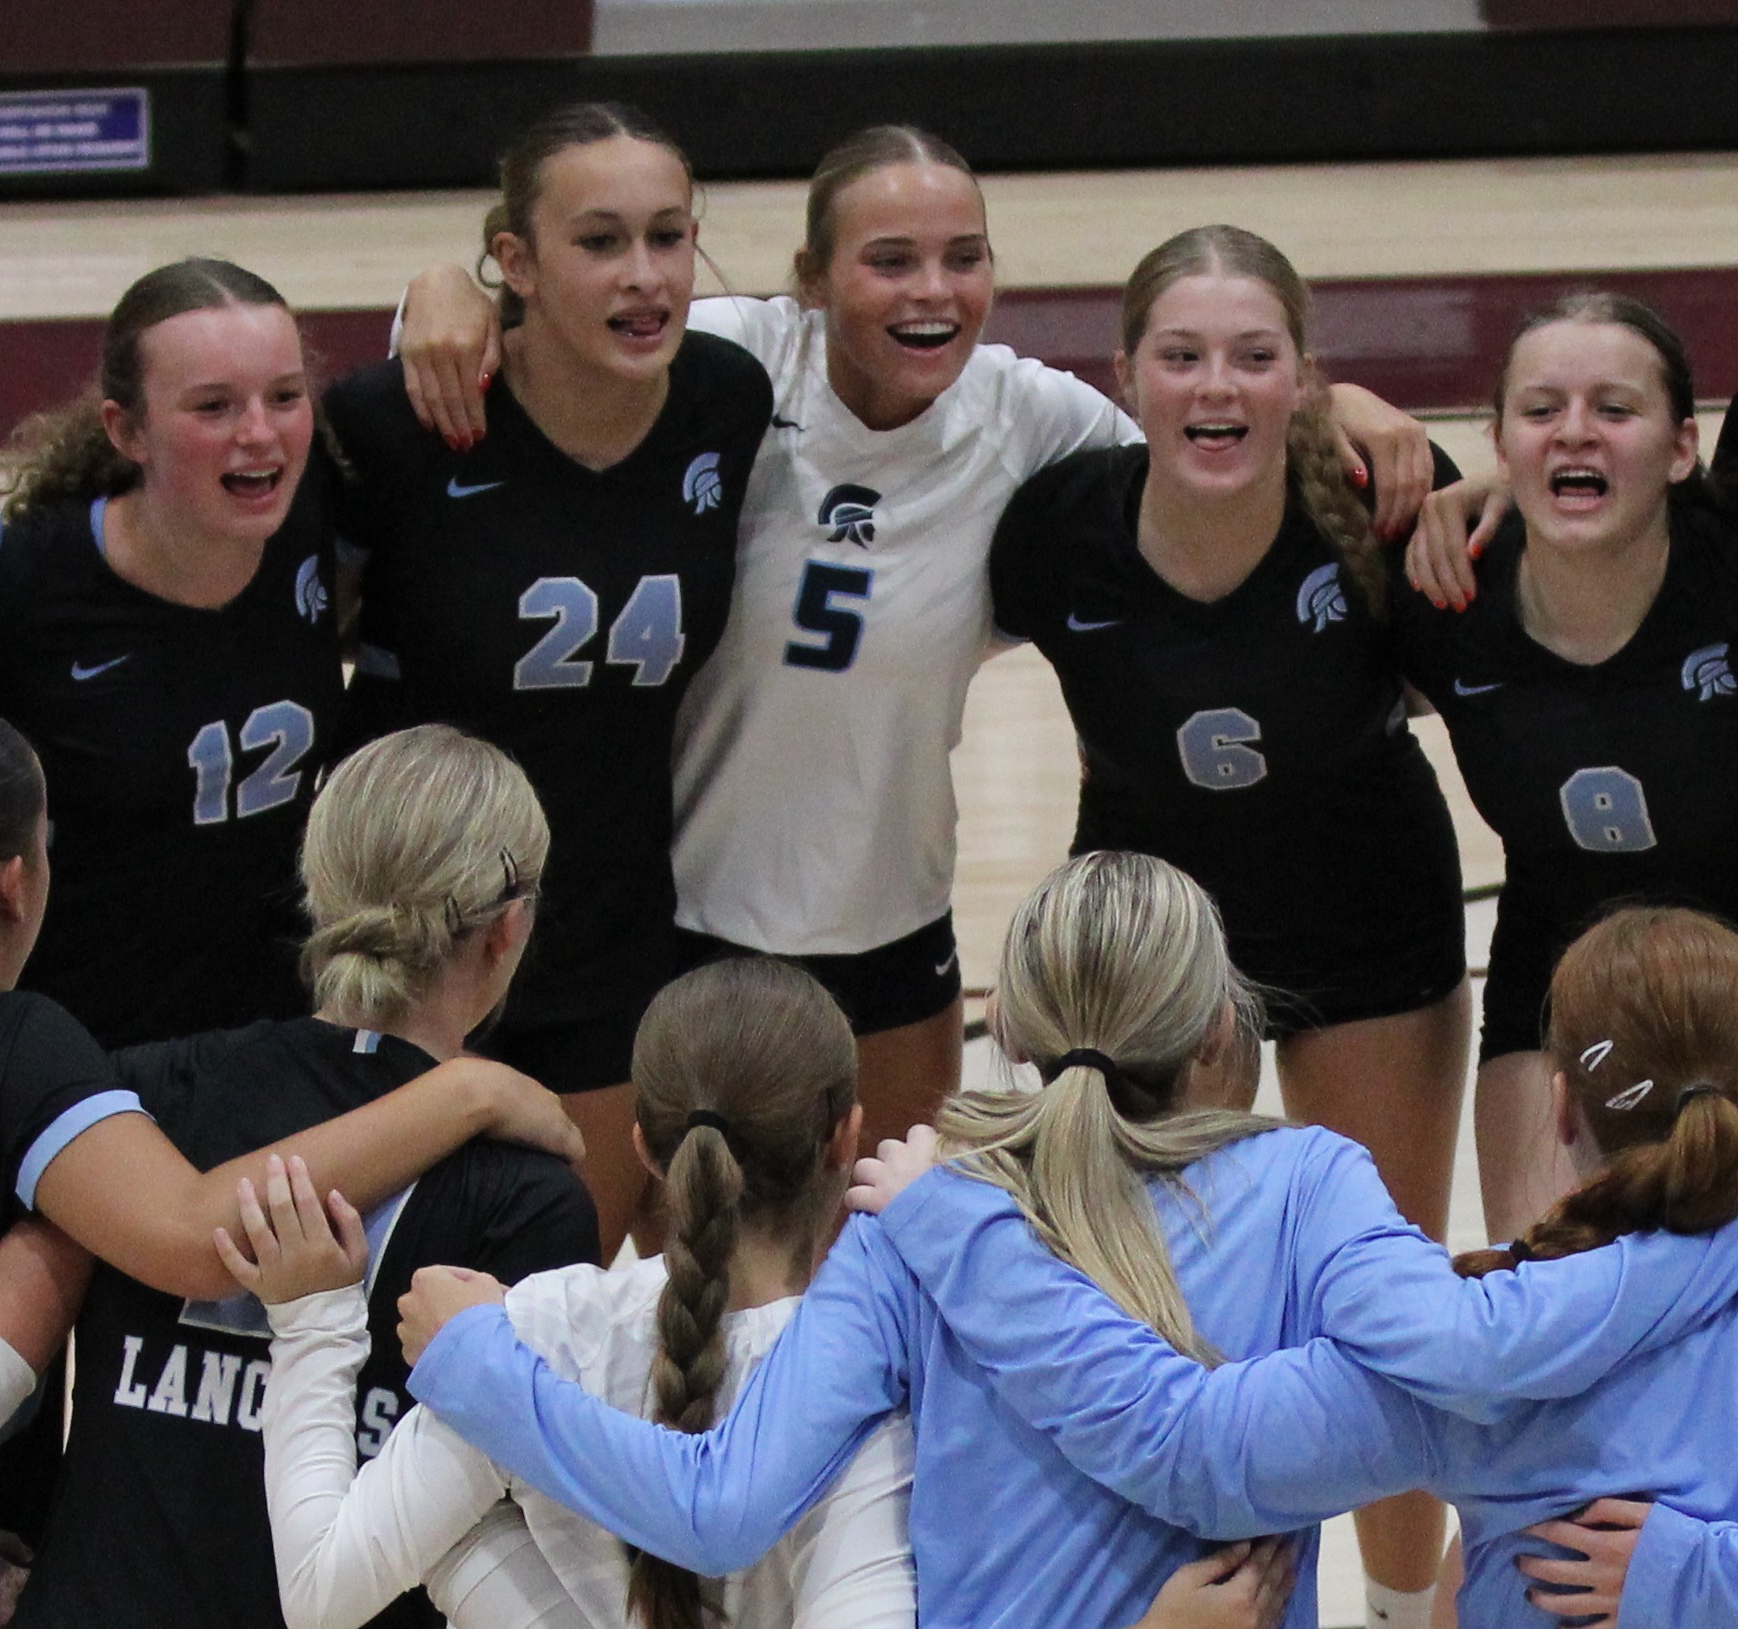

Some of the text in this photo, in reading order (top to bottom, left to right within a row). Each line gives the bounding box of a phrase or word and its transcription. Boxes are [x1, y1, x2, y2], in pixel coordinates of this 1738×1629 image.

[514, 574, 686, 690] 24
[783, 558, 876, 673] 5
[187, 699, 315, 825] 12
[1176, 707, 1268, 790] 6
[1559, 766, 1658, 852] 8
[113, 1334, 400, 1458] LANCS
